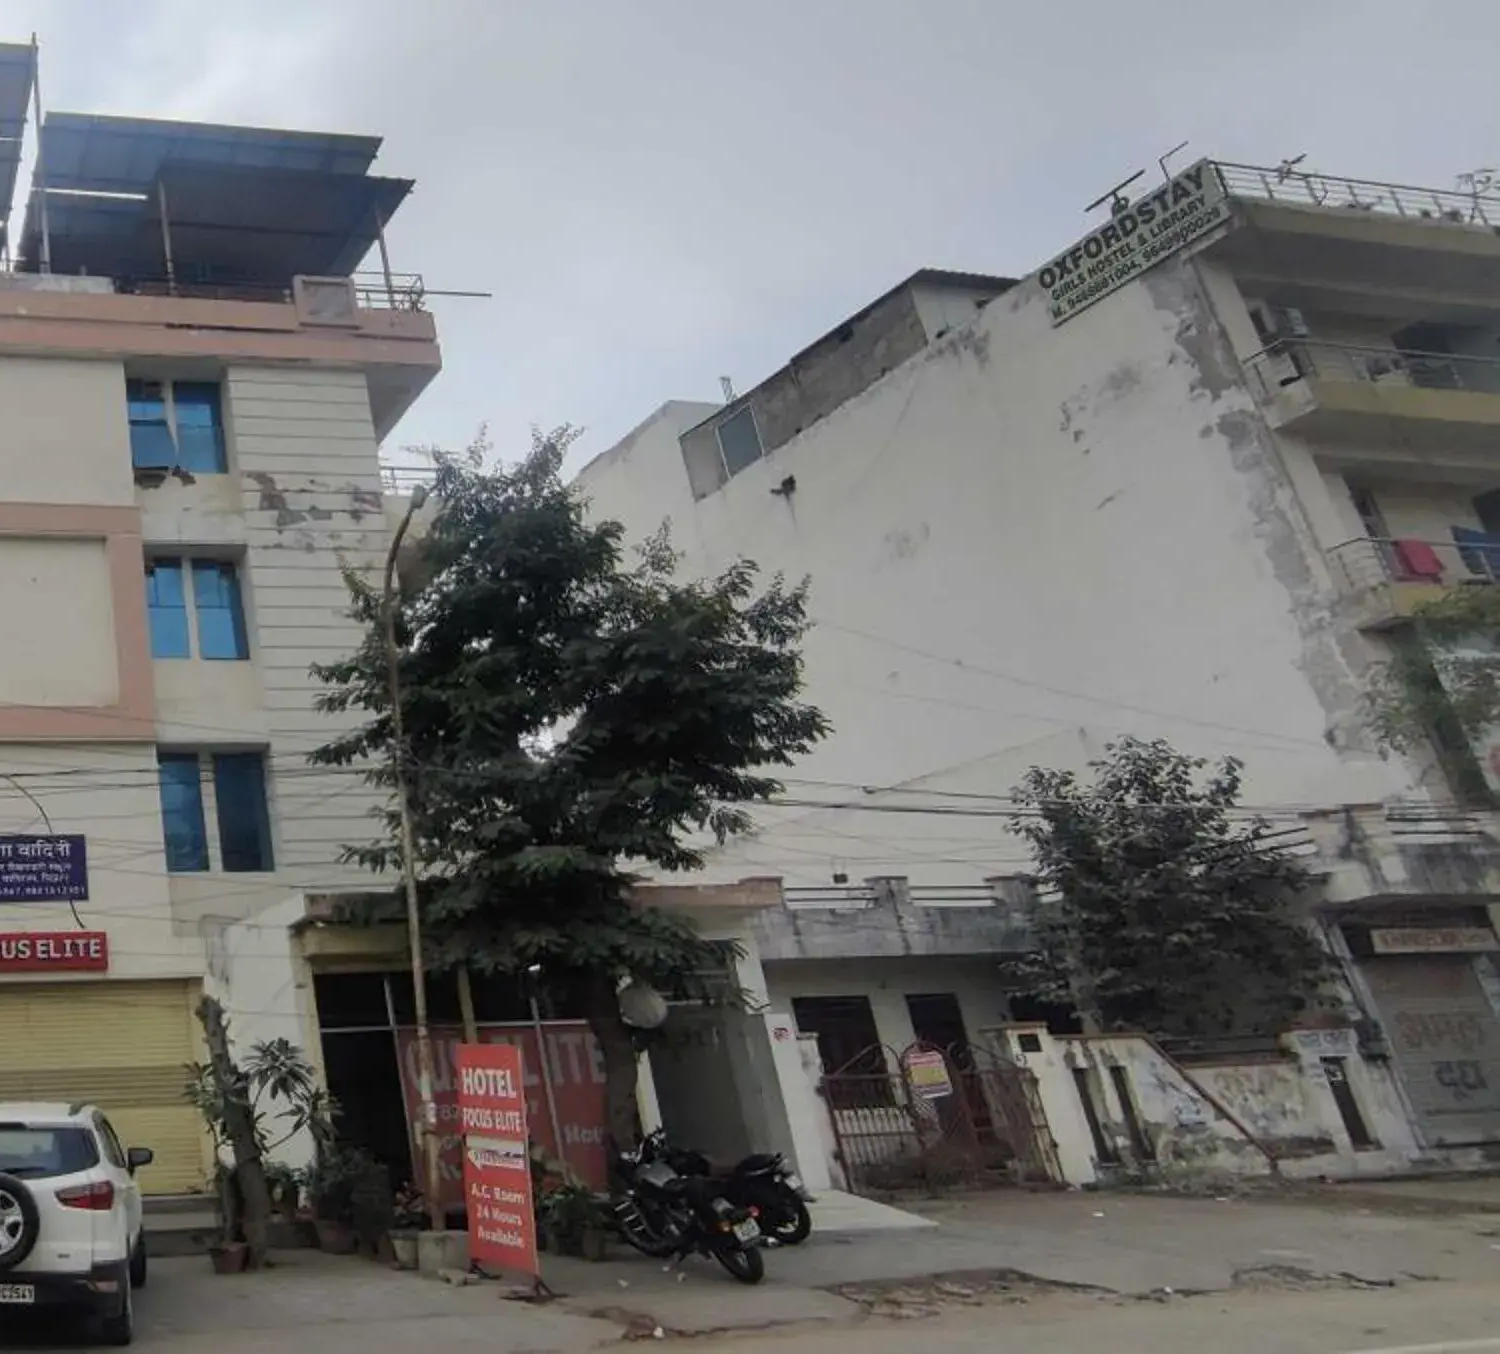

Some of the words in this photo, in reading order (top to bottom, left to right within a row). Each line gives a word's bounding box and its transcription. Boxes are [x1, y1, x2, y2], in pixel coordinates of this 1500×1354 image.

[1038, 166, 1204, 289] OXFORDSTAY
[1051, 272, 1087, 301] GIRLS
[1087, 243, 1134, 275] HOSTEL
[1137, 232, 1148, 245] &
[1148, 194, 1206, 241] LIBRARY
[36, 939, 102, 959] ELITE
[462, 1067, 516, 1099] HOTEL
[462, 1107, 493, 1130] FOCUS
[494, 1110, 523, 1132] ELITE
[493, 1187, 525, 1204] Room
[491, 1207, 522, 1226] Hours
[477, 1225, 525, 1248] Available
